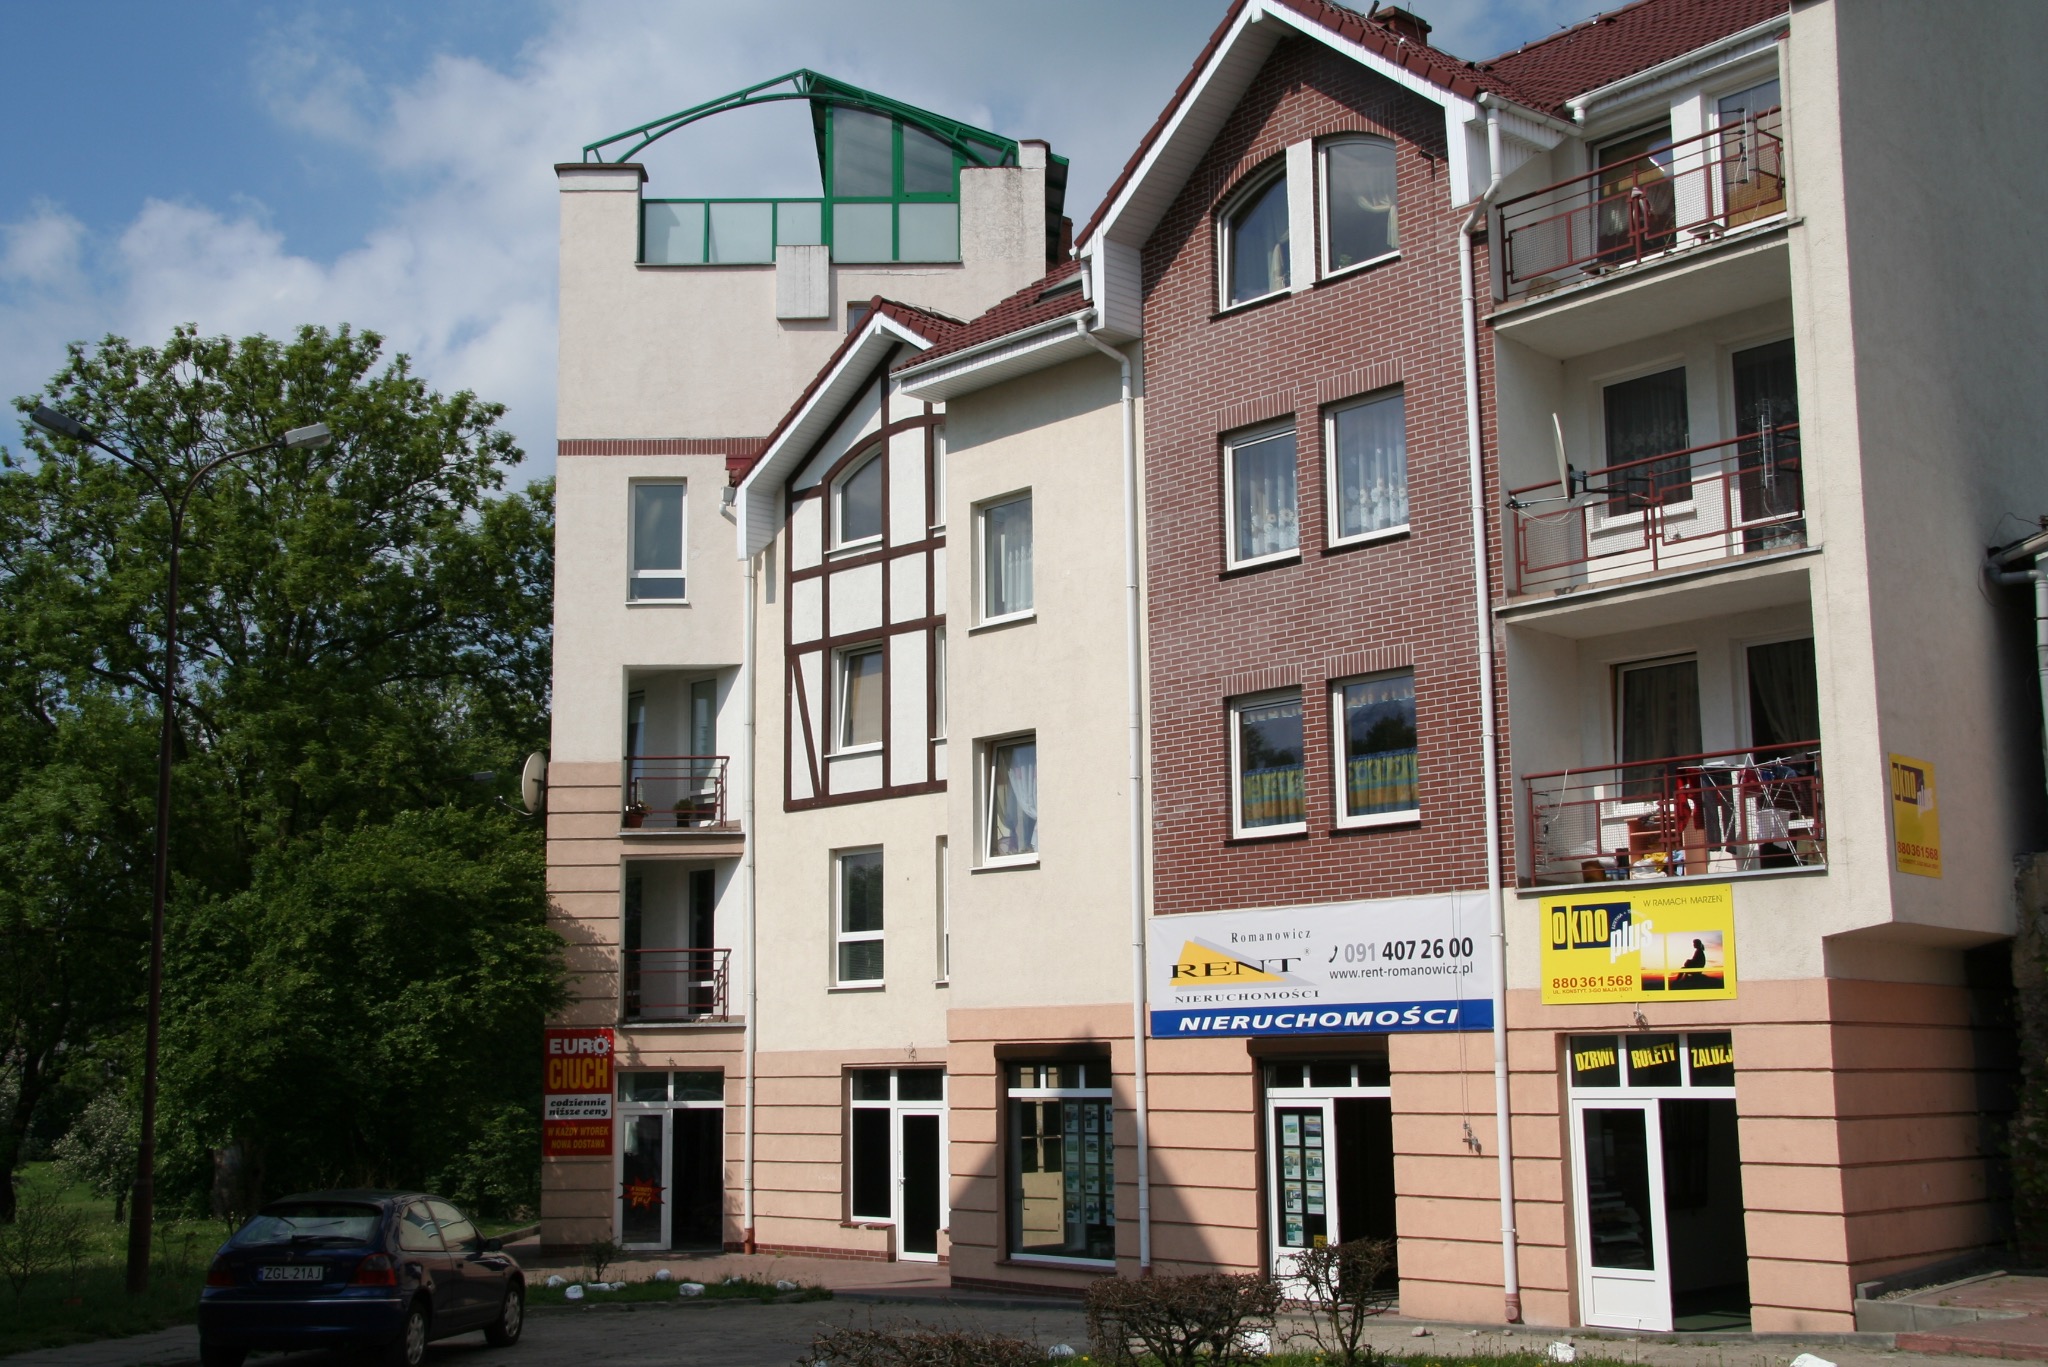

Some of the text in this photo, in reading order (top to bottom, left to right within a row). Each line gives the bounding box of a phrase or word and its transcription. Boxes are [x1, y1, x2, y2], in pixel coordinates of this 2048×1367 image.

[1643, 894, 1722, 907] W RAMACH MARZEŃ
[1231, 928, 1311, 943] Romanowicz
[1610, 920, 1653, 964] plus
[1345, 943, 1376, 963] 091
[1170, 957, 1301, 979] RENT
[1329, 962, 1473, 980] www.rent-romanowicz.pl
[1175, 990, 1319, 1003] NIERUCHOMOŚCI
[1179, 1006, 1459, 1031] NIERUCHOMOŚCI
[550, 1037, 609, 1054] EURO
[1631, 1042, 1675, 1068] ROLETY
[549, 1058, 608, 1090] CIUCH
[550, 1098, 606, 1107] codziennie
[583, 1109, 608, 1117] ceny
[548, 1128, 554, 1136] W
[580, 1126, 608, 1136] WTOREK
[552, 1140, 605, 1148] NOWA DOSTAWA
[265, 1268, 320, 1279] ZGL 21AJ
